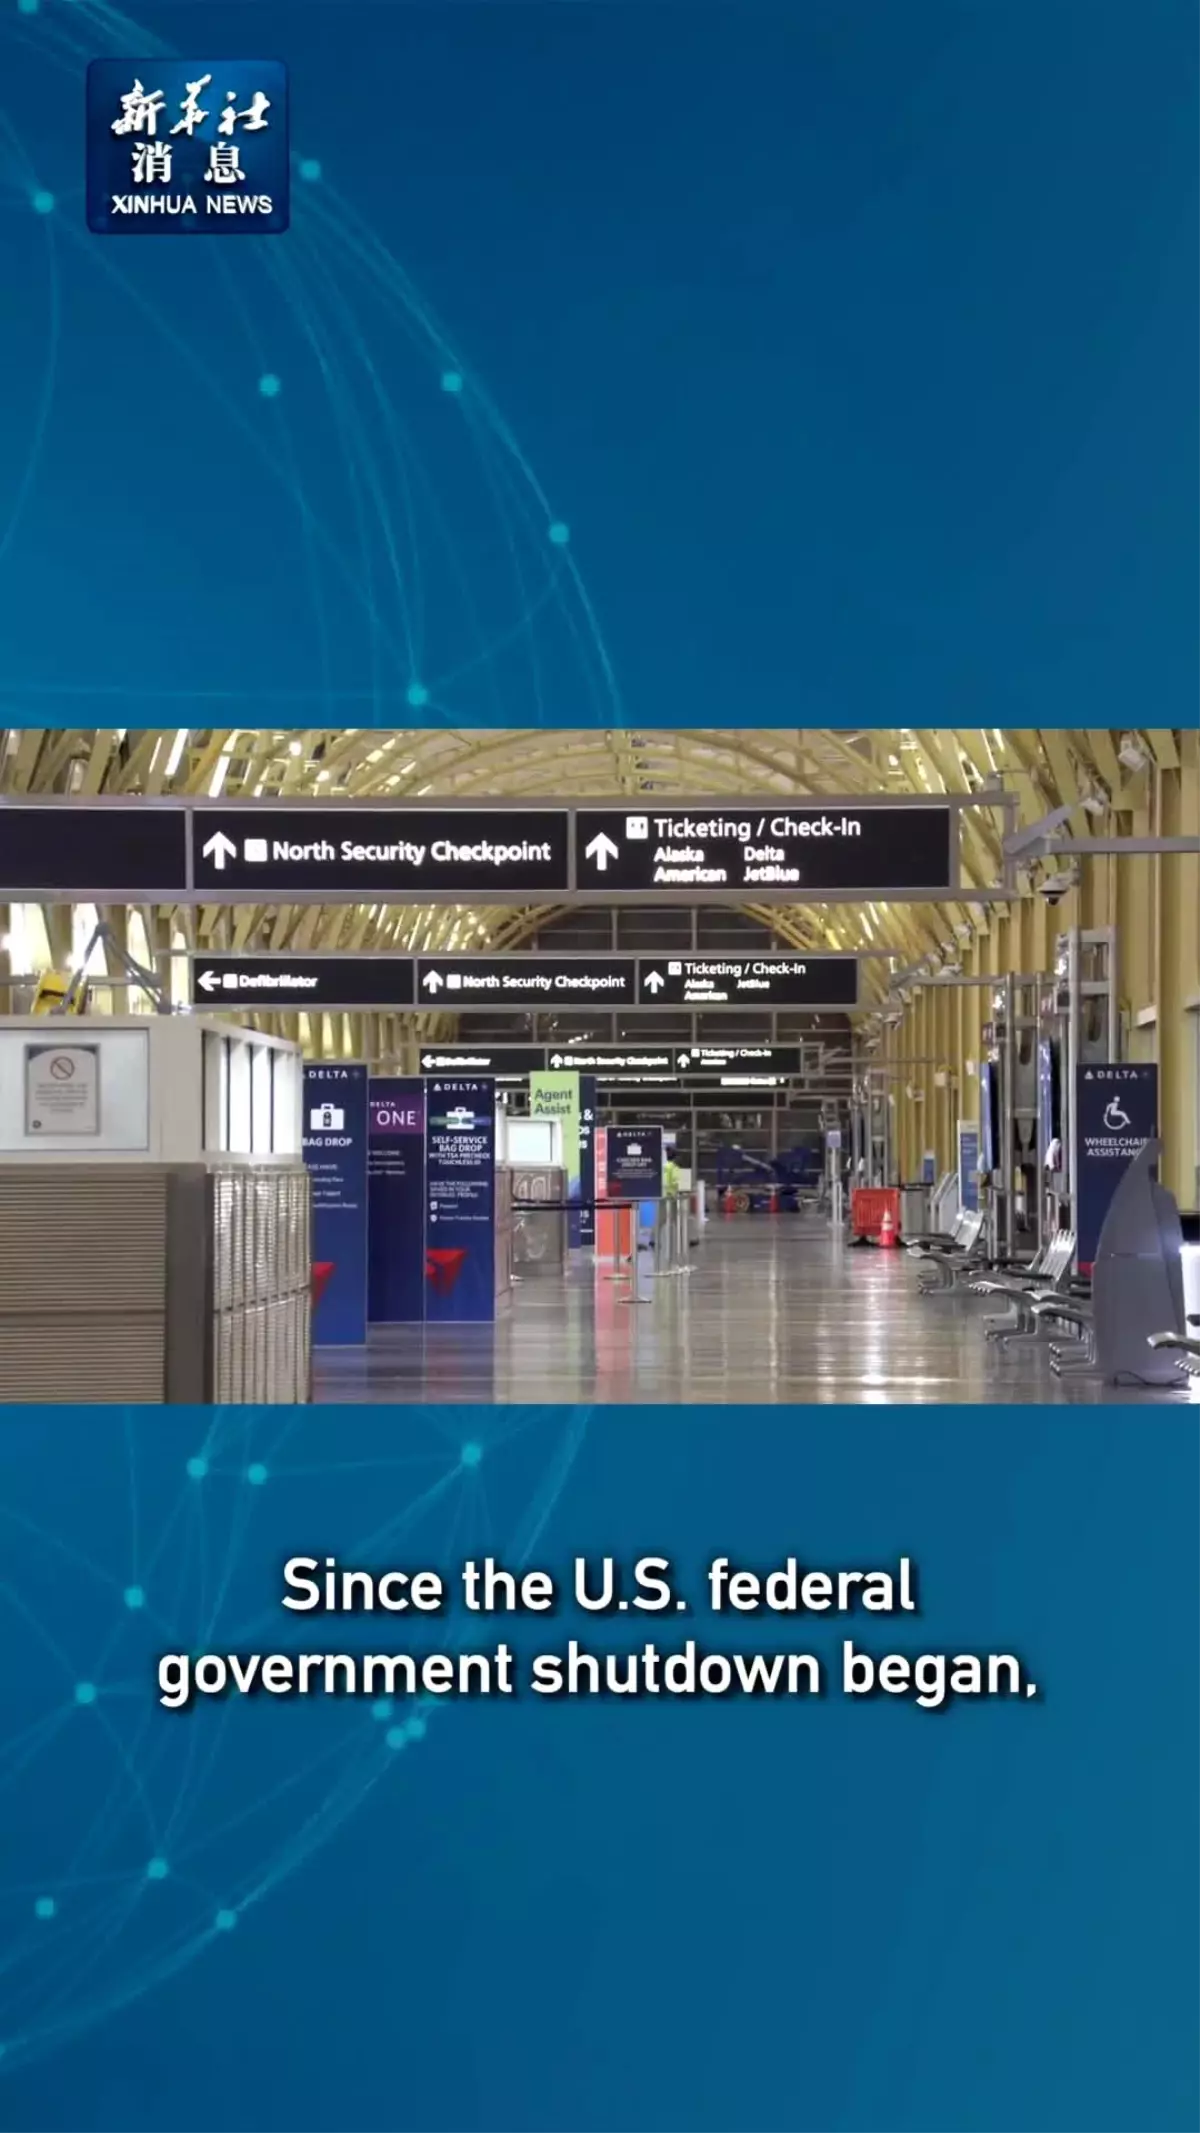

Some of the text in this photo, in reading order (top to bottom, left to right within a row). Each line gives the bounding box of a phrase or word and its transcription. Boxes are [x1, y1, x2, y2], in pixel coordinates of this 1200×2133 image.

[654, 817, 752, 843] Ticketing
[770, 815, 861, 838] Check-In
[272, 839, 552, 866] North Security Checkpoint
[653, 844, 785, 864] Alaska Delta
[653, 864, 801, 884] American JetBlue
[684, 962, 743, 978] Ticketing
[752, 961, 806, 975] Check-In
[238, 972, 319, 989] Defibrillator
[462, 974, 627, 992] North Security Checkpoint
[308, 1070, 348, 1079] DELTA
[1096, 1069, 1139, 1080] DELTA
[443, 1083, 479, 1091] DELTA
[535, 1088, 573, 1103] Agent
[534, 1102, 572, 1115] Assist
[376, 1110, 417, 1126] ONE
[302, 1137, 353, 1147] BAG DROP
[431, 1135, 488, 1145] SELF-SERVICE
[439, 1143, 483, 1153] BAG DROP
